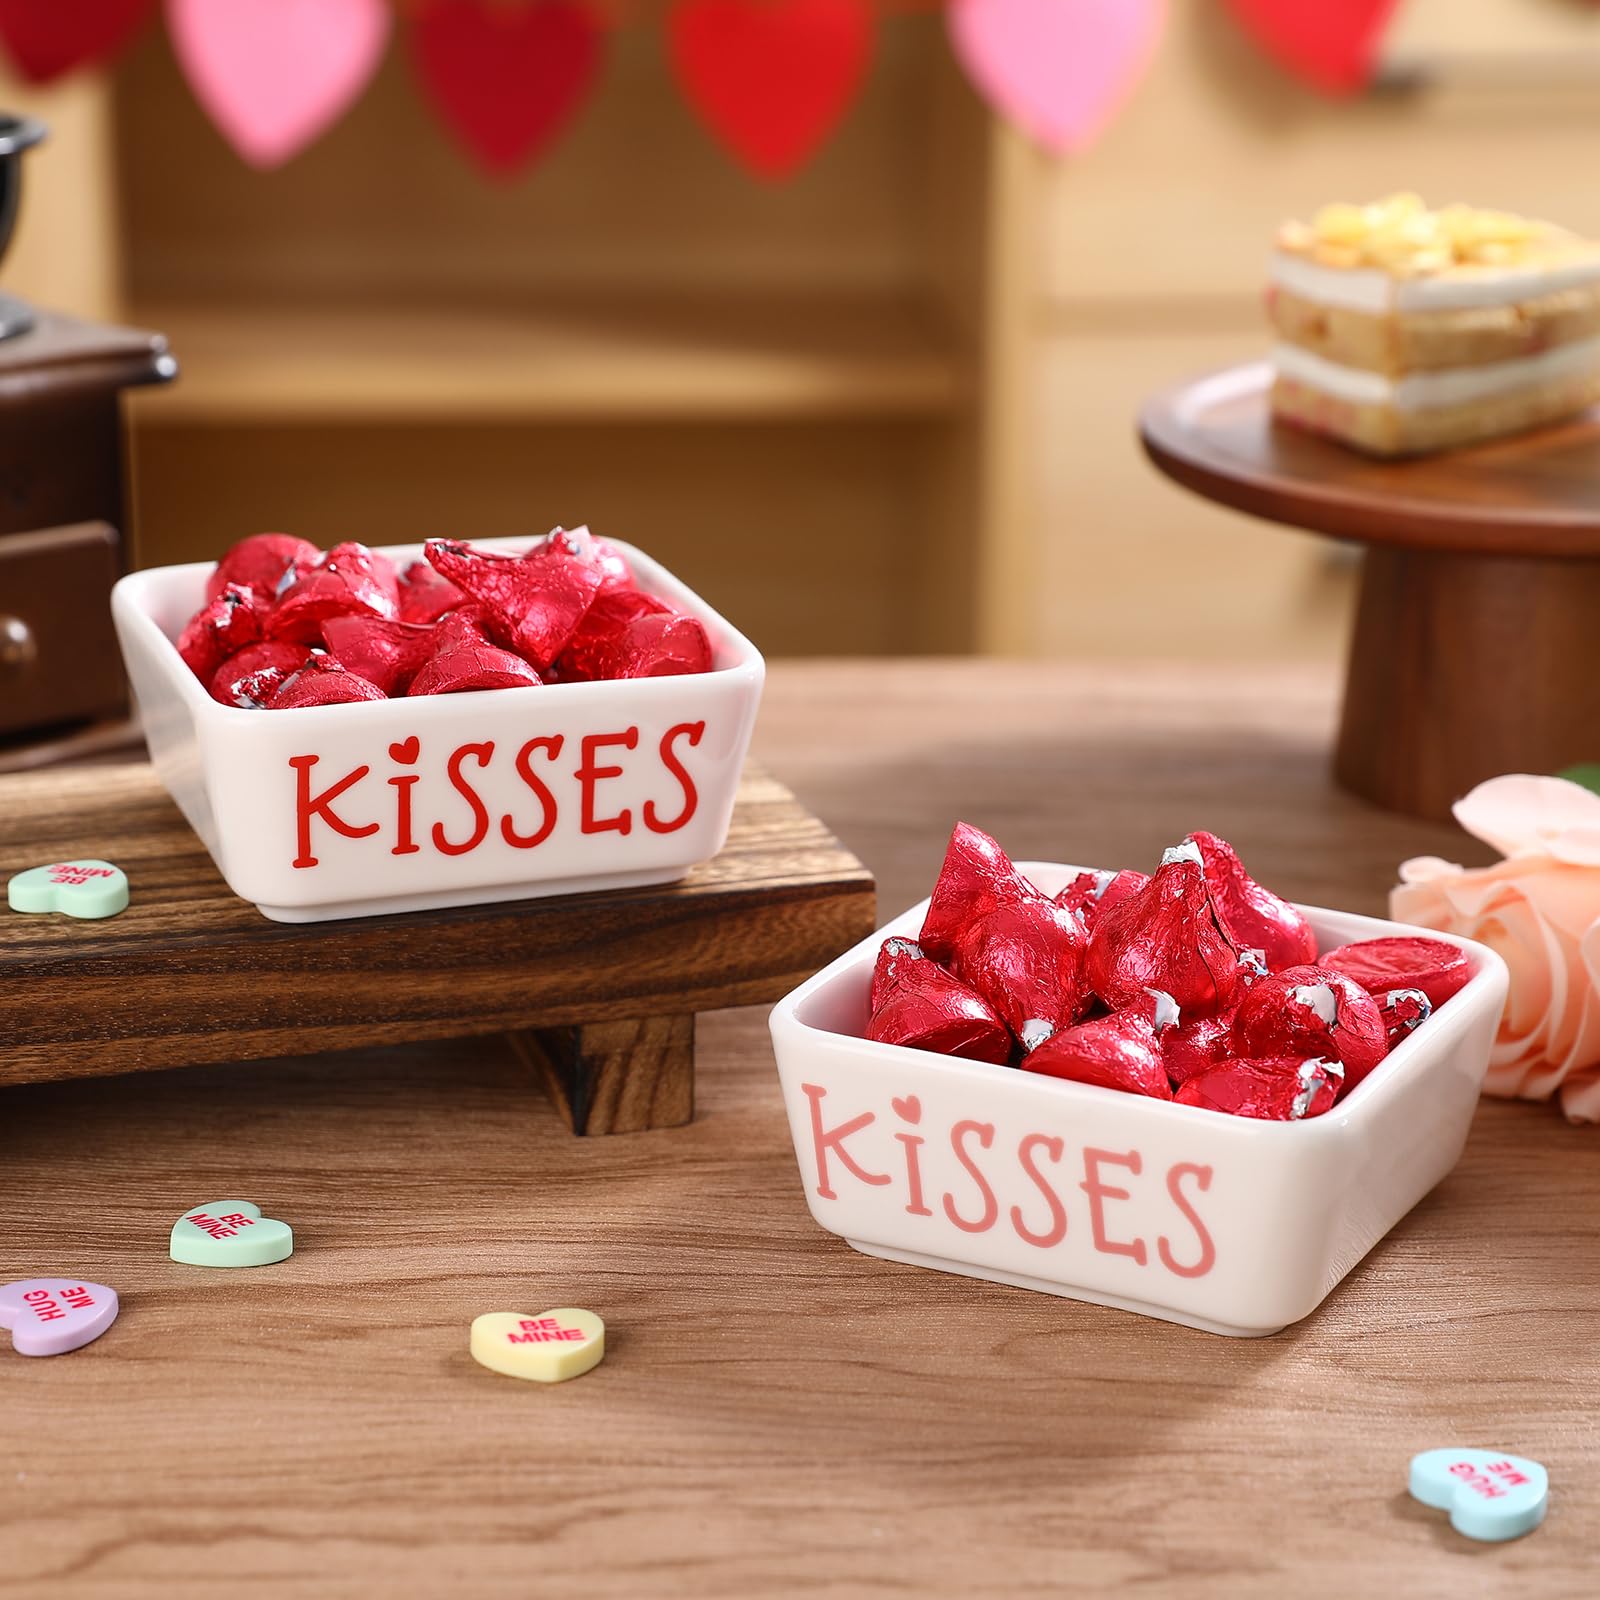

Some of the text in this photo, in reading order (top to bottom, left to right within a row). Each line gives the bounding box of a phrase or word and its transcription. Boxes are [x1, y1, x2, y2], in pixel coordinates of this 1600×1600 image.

[186, 1213, 239, 1240] MINE
[219, 1212, 255, 1229] BE
[24, 1290, 66, 1322] HUG
[60, 1286, 95, 1309] ME
[519, 1319, 560, 1331] BE
[508, 1329, 586, 1344] MINE
